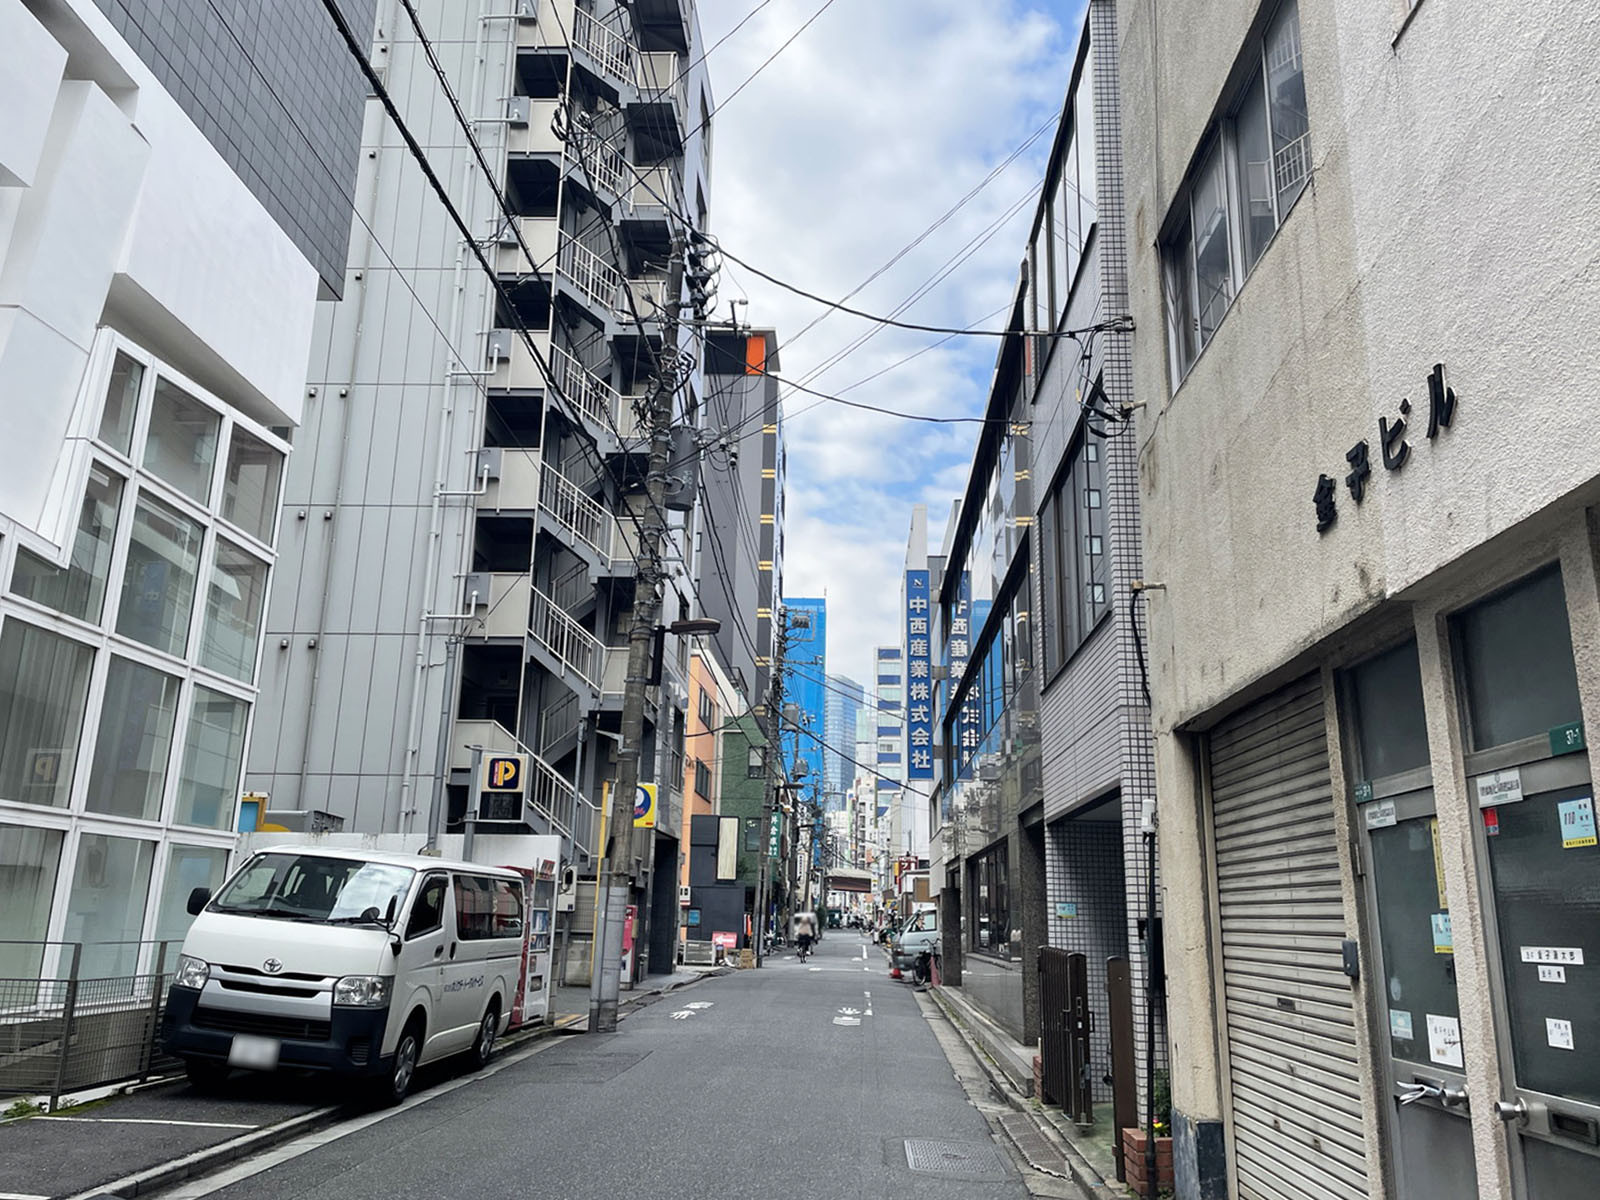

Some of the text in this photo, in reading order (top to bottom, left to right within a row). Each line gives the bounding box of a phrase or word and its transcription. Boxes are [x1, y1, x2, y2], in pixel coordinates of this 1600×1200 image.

[1313, 363, 1458, 533] 金子ビル
[909, 595, 931, 769] 中西産業株式会社
[496, 760, 516, 786] P
